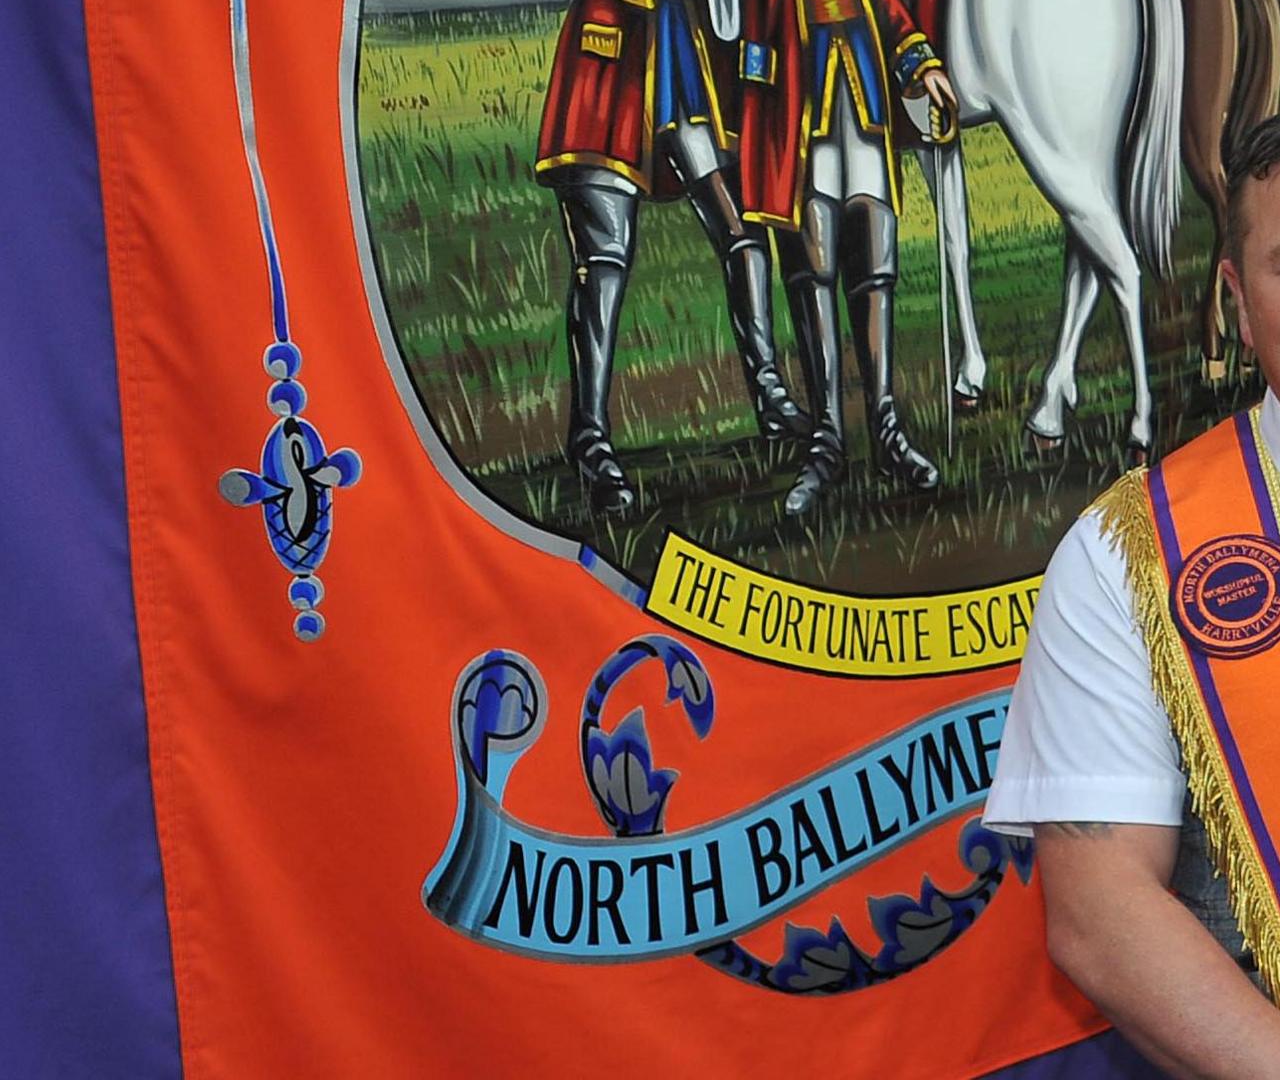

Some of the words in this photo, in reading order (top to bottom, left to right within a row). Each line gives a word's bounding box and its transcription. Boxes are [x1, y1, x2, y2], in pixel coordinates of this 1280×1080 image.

[1184, 561, 1208, 603] NORTH
[1205, 545, 1280, 574] BALLYMENA
[1203, 573, 1265, 599] WORSHIPFUL
[1216, 585, 1257, 607] MASTER
[669, 550, 737, 629] THE
[738, 584, 931, 663] FORTUNATE
[484, 840, 732, 946] NORTH
[745, 706, 1009, 910] BALLYME
